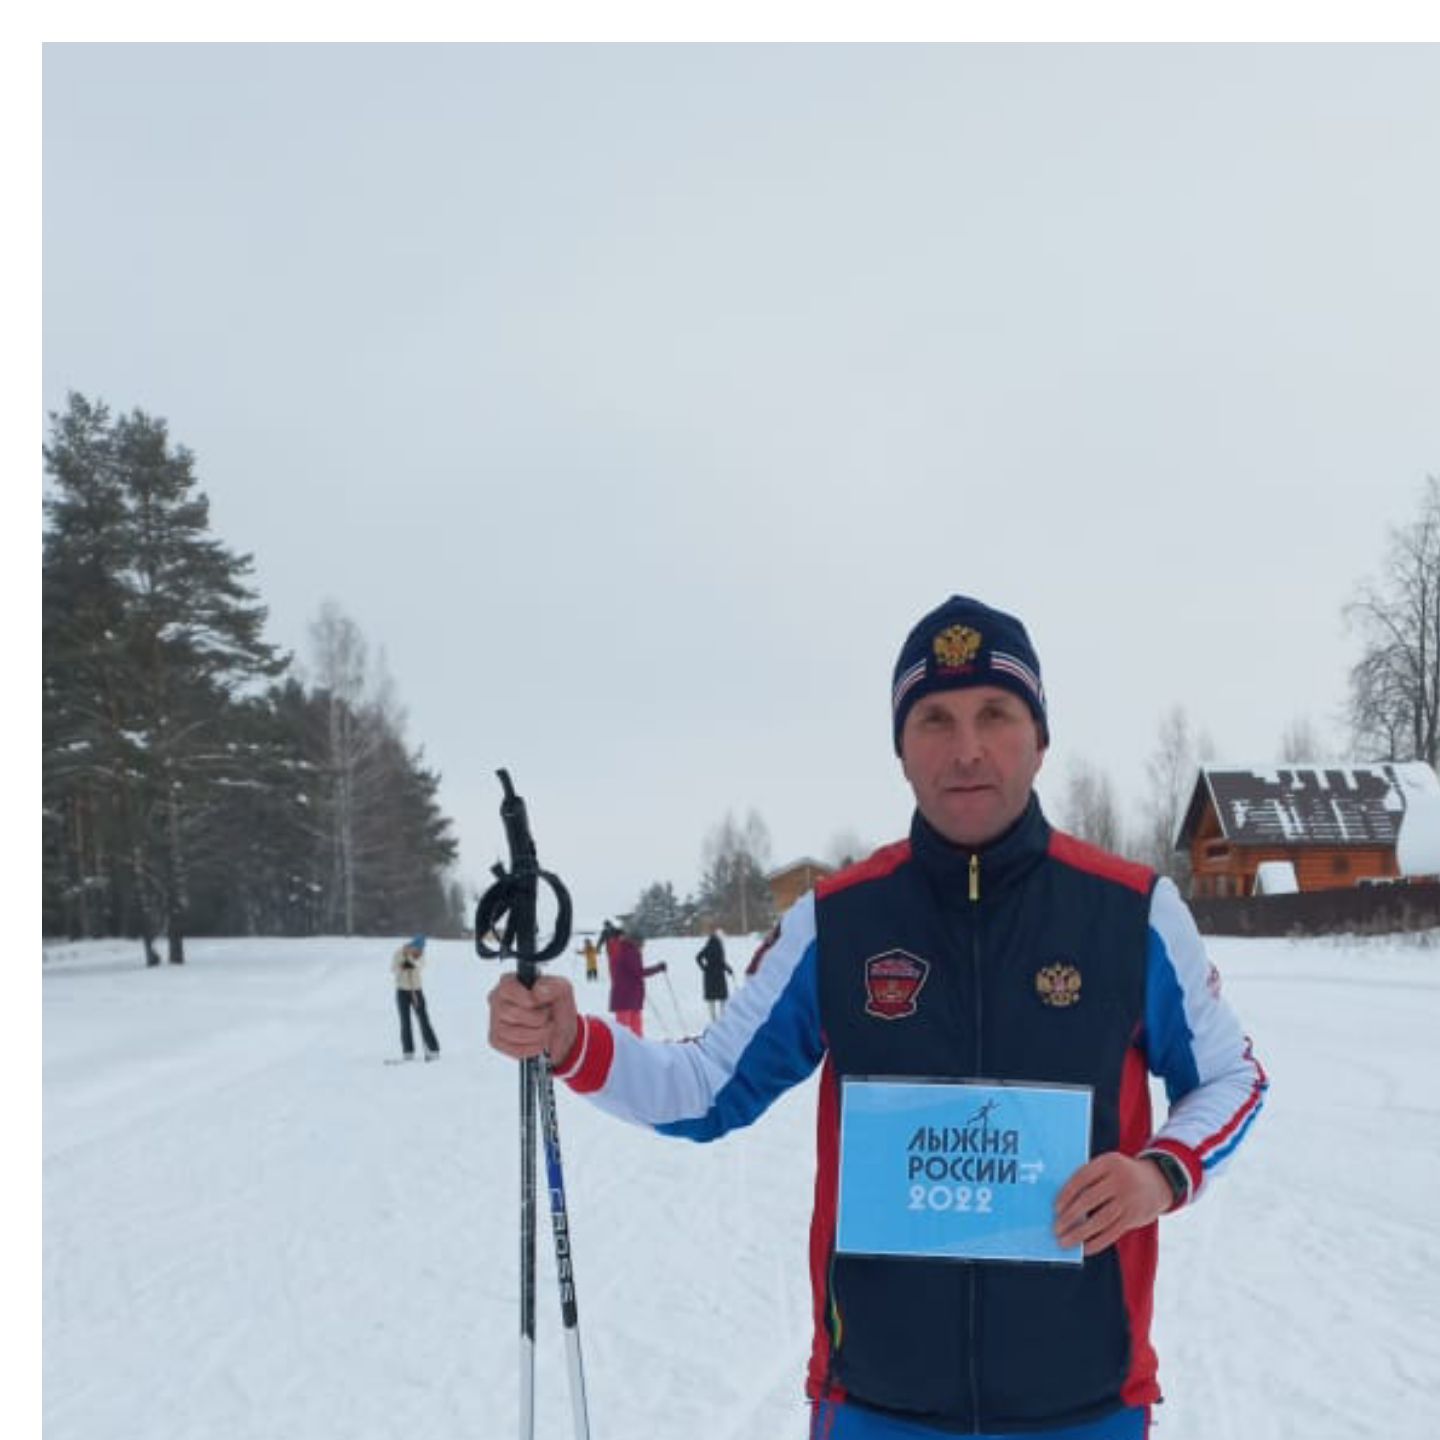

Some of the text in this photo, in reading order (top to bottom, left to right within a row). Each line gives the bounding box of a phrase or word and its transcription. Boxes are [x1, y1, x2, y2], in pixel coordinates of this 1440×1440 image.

[907, 1126, 1019, 1154] ЛЫЖНЯ
[908, 1156, 1018, 1185] РОССИИ
[908, 1185, 993, 1213] 2022
